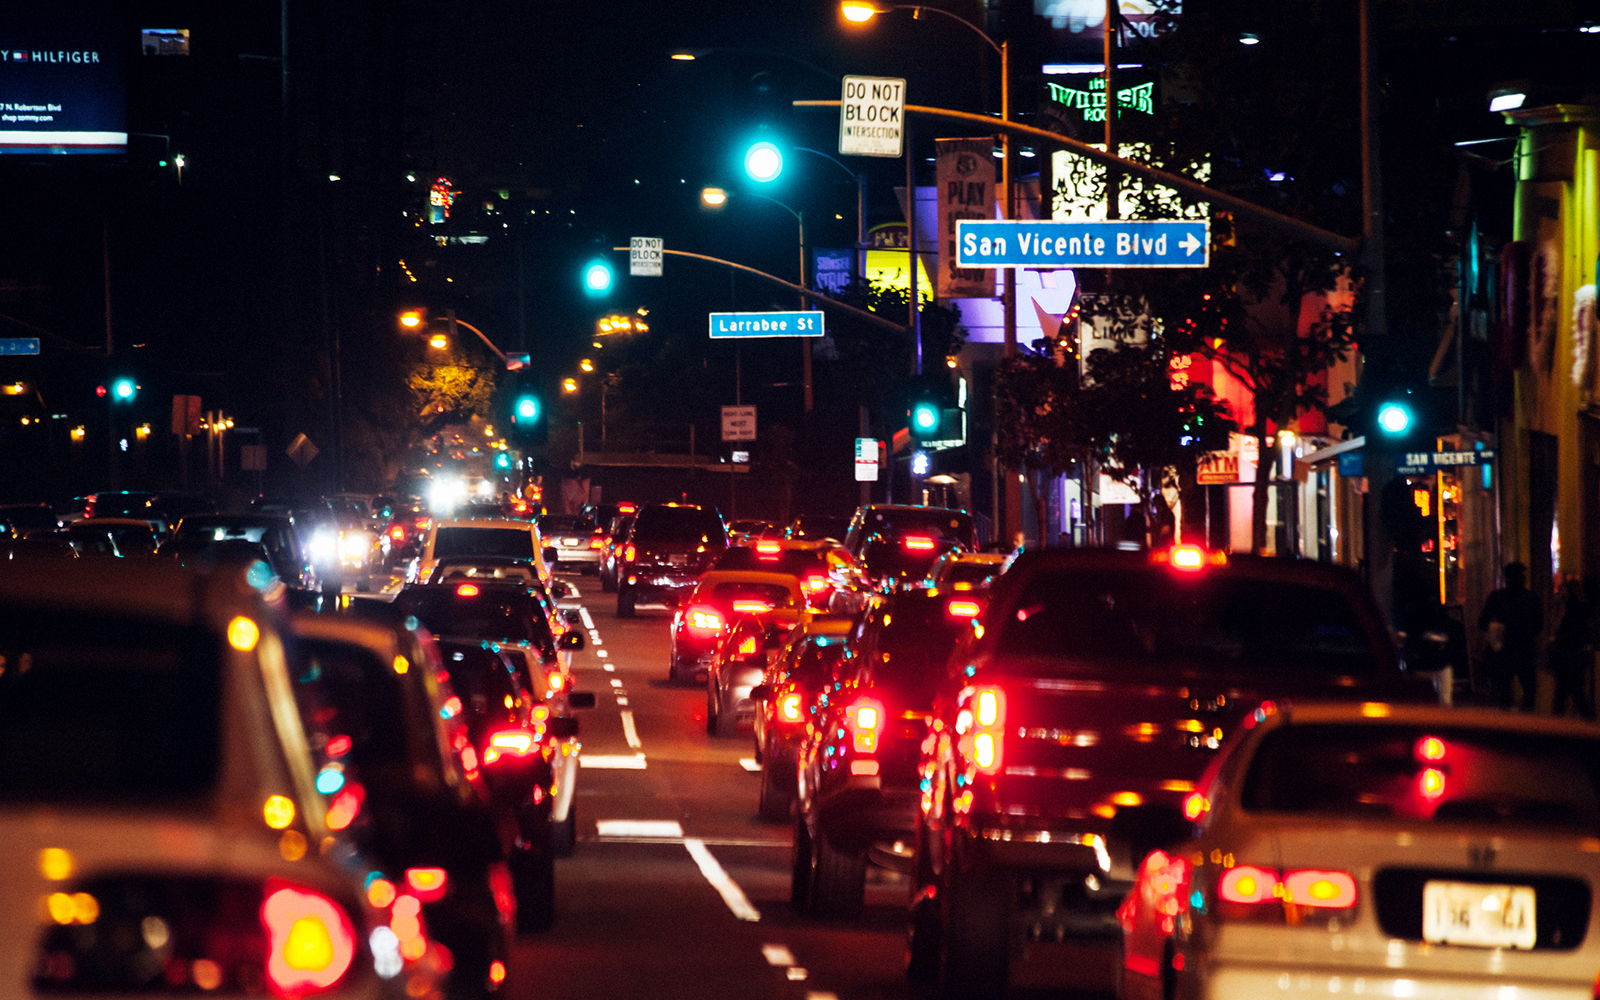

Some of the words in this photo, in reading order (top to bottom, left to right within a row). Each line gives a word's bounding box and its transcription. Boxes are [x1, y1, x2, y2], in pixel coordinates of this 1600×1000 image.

[32, 51, 100, 63] HILFIGER
[846, 81, 866, 100] DO
[872, 83, 902, 102] NOT
[14, 103, 47, 112] Robertson
[47, 103, 62, 112] Blvd
[845, 103, 900, 123] BLOCK
[843, 126, 901, 140] INTERSECTION
[948, 181, 986, 206] PLAY
[631, 238, 643, 249] DO
[645, 239, 662, 249] NOT
[963, 232, 1007, 257] San
[1017, 232, 1105, 257] Vicente
[1116, 232, 1167, 257] Blvd
[631, 250, 661, 260] BLOCK
[719, 319, 788, 332] Larrabee
[797, 317, 814, 331] St
[1199, 456, 1239, 473] ATM
[1405, 452, 1428, 466] SAN
[1432, 451, 1476, 466] VICENTE
